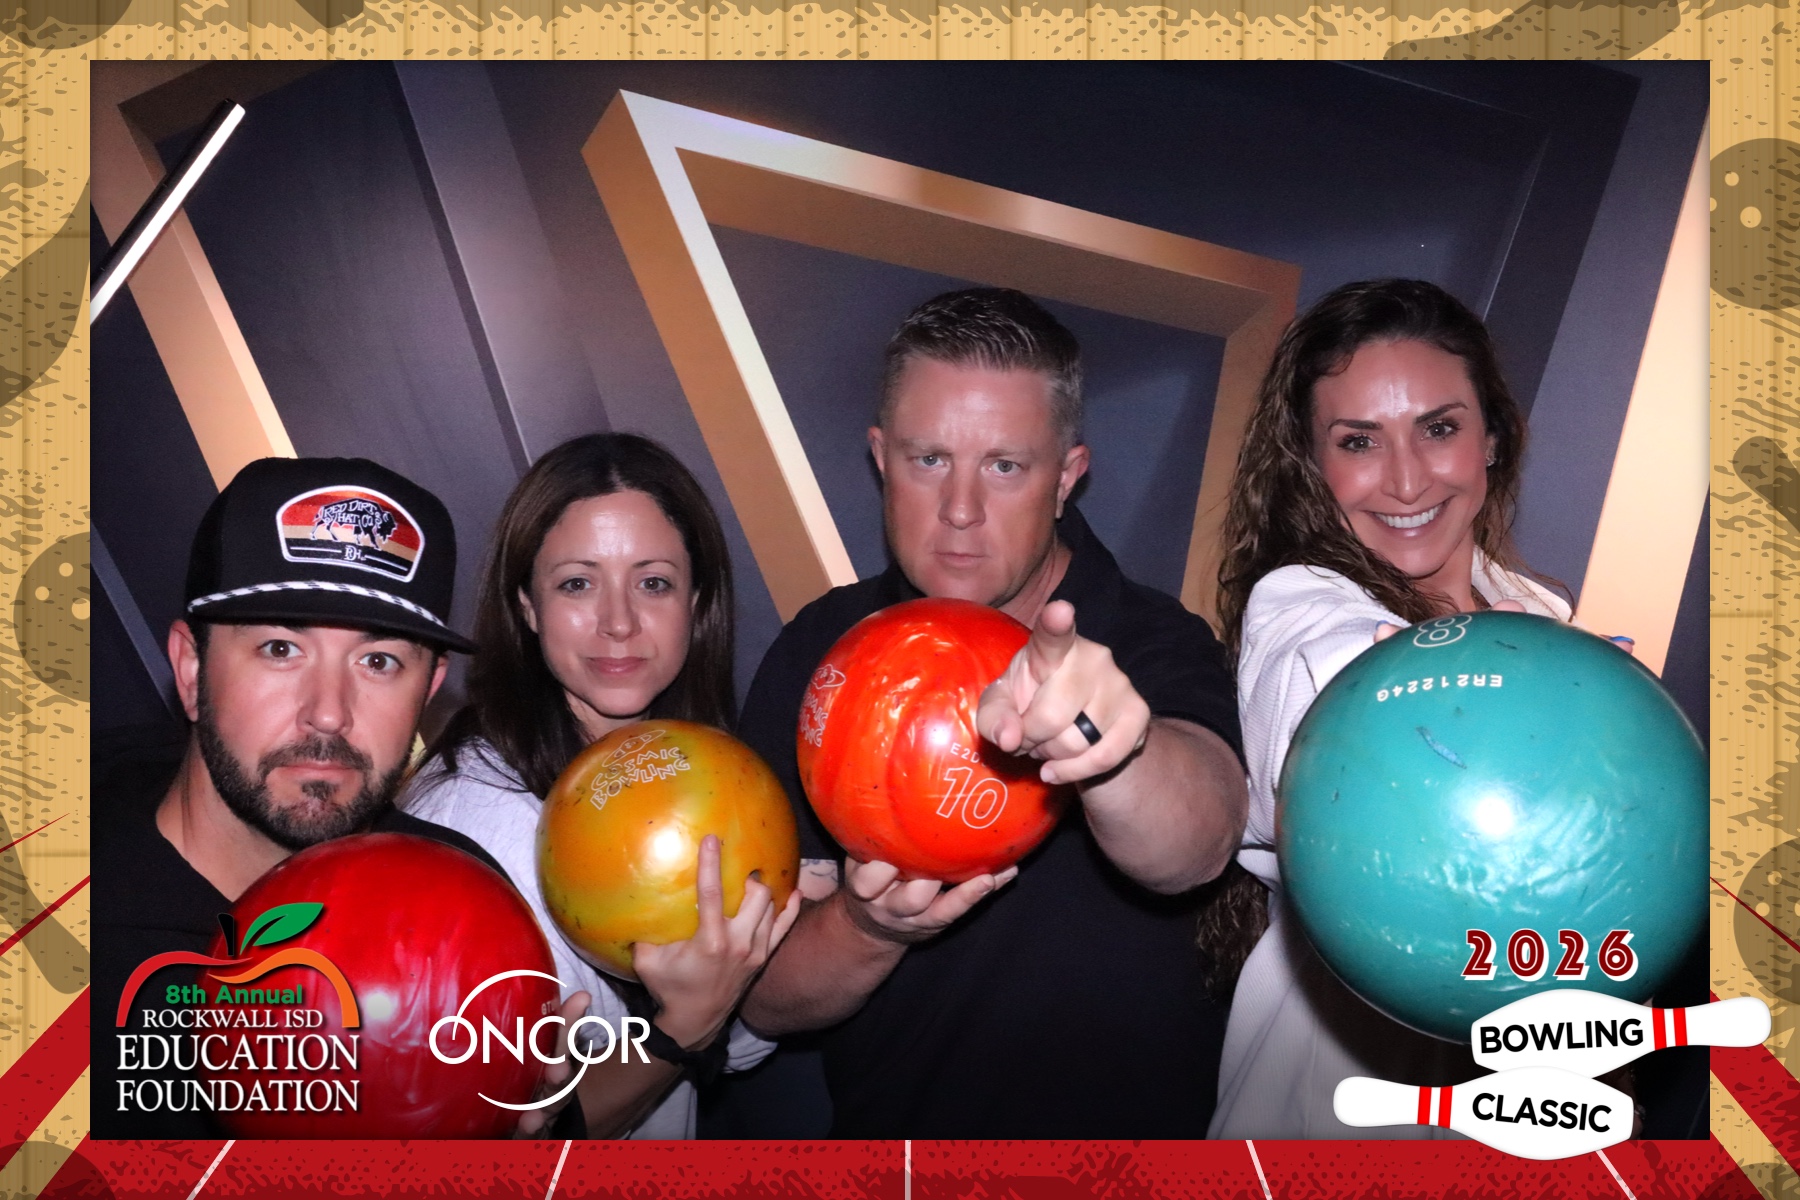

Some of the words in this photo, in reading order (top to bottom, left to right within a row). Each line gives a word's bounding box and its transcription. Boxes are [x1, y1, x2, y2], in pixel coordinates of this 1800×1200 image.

[324, 503, 347, 520] RED
[348, 500, 377, 516] DIRT
[337, 512, 359, 523] HAT
[1413, 614, 1473, 648] 8
[590, 746, 686, 791] COSMIC
[590, 758, 691, 811] BOWLING
[936, 766, 1009, 829] 10
